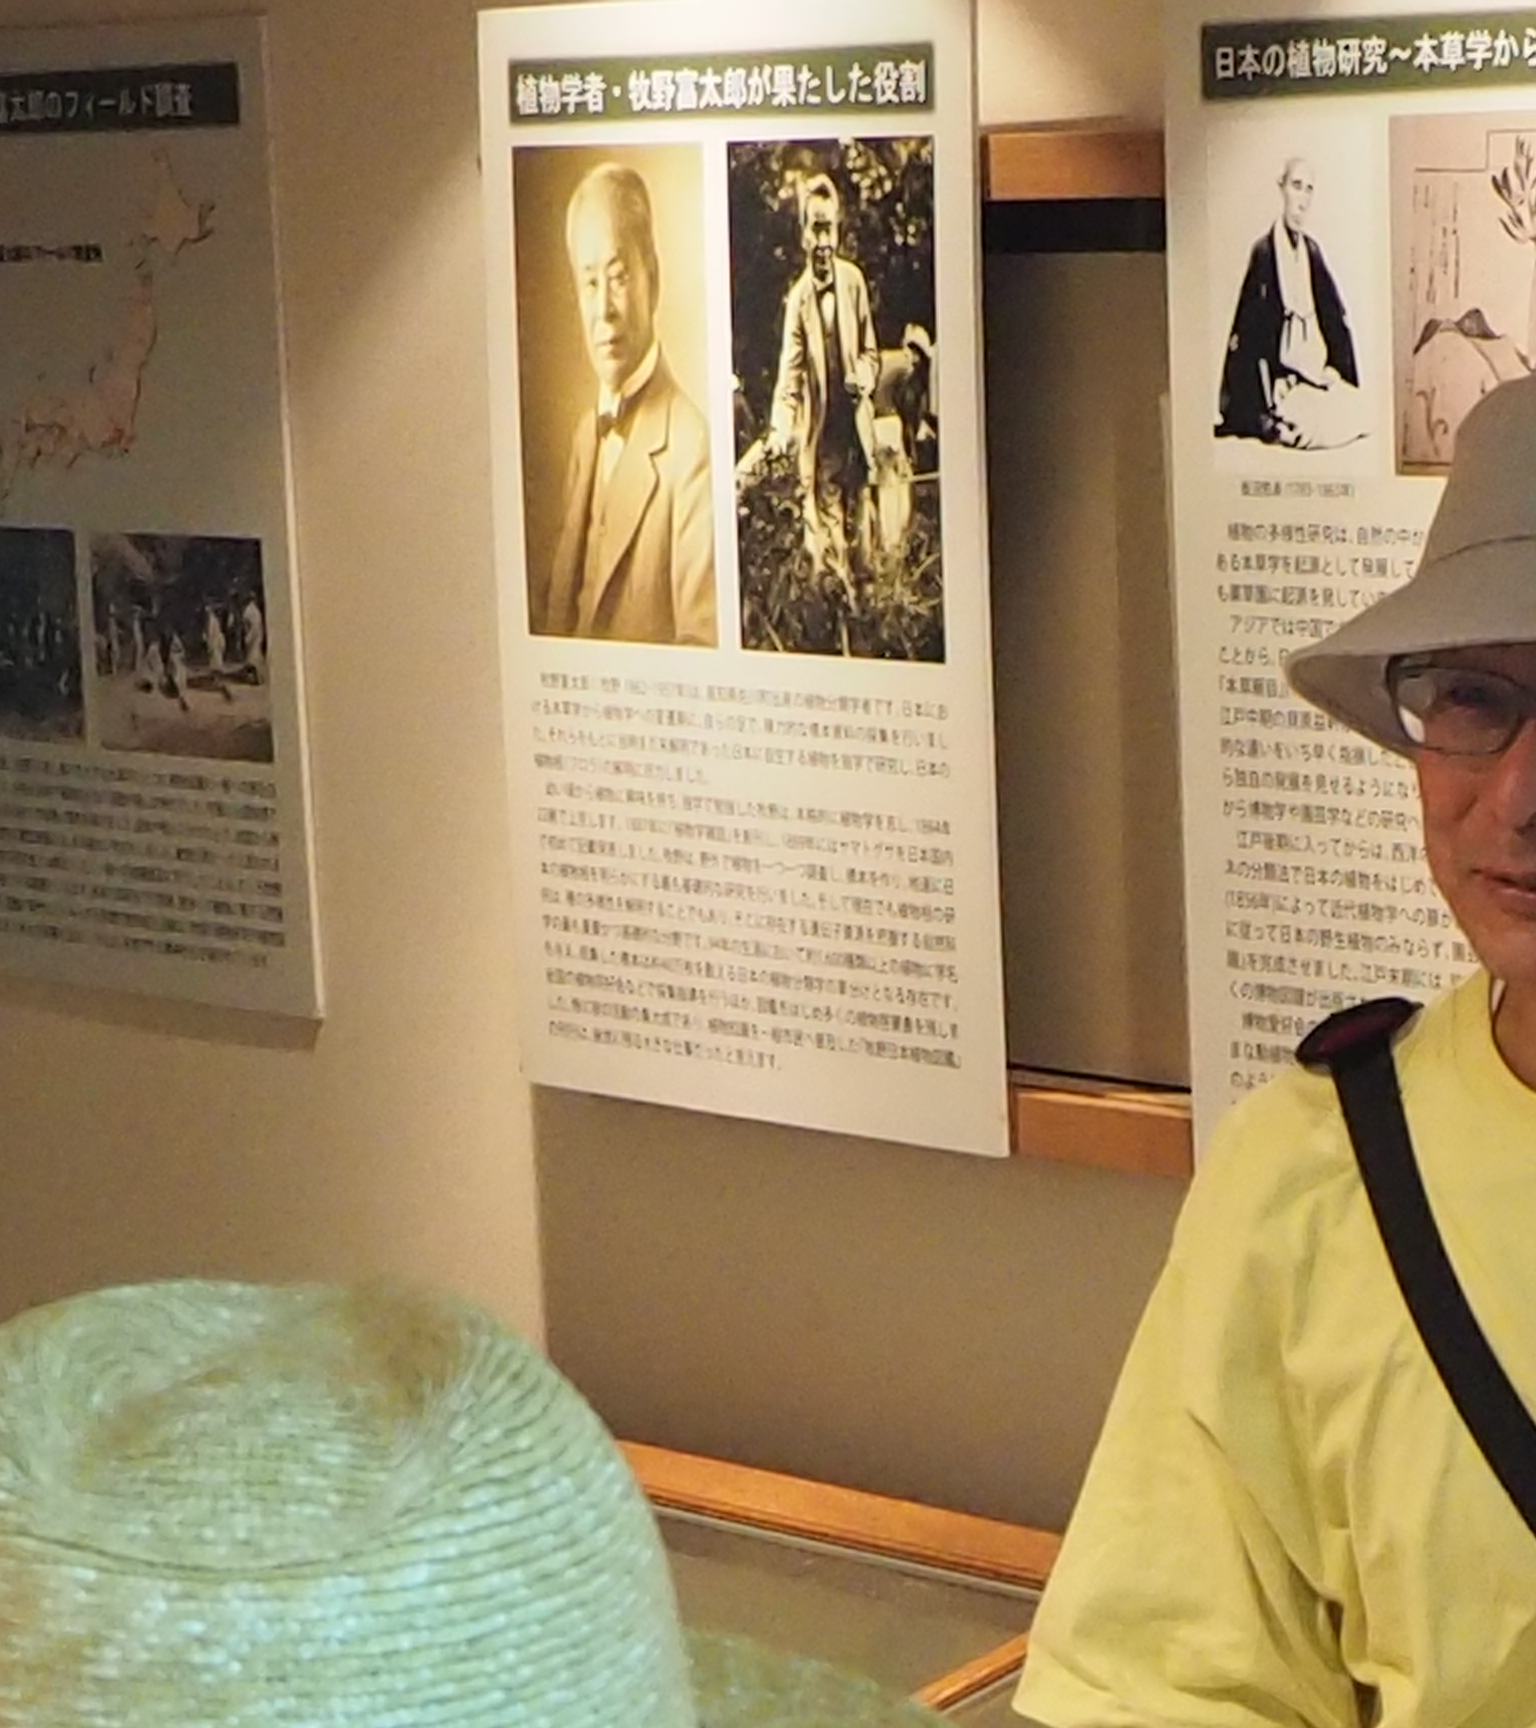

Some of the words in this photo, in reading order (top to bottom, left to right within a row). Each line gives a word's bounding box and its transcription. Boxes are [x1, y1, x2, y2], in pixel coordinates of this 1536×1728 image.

[515, 59, 927, 116] 植物学者・牧野富太郎が果たした役割
